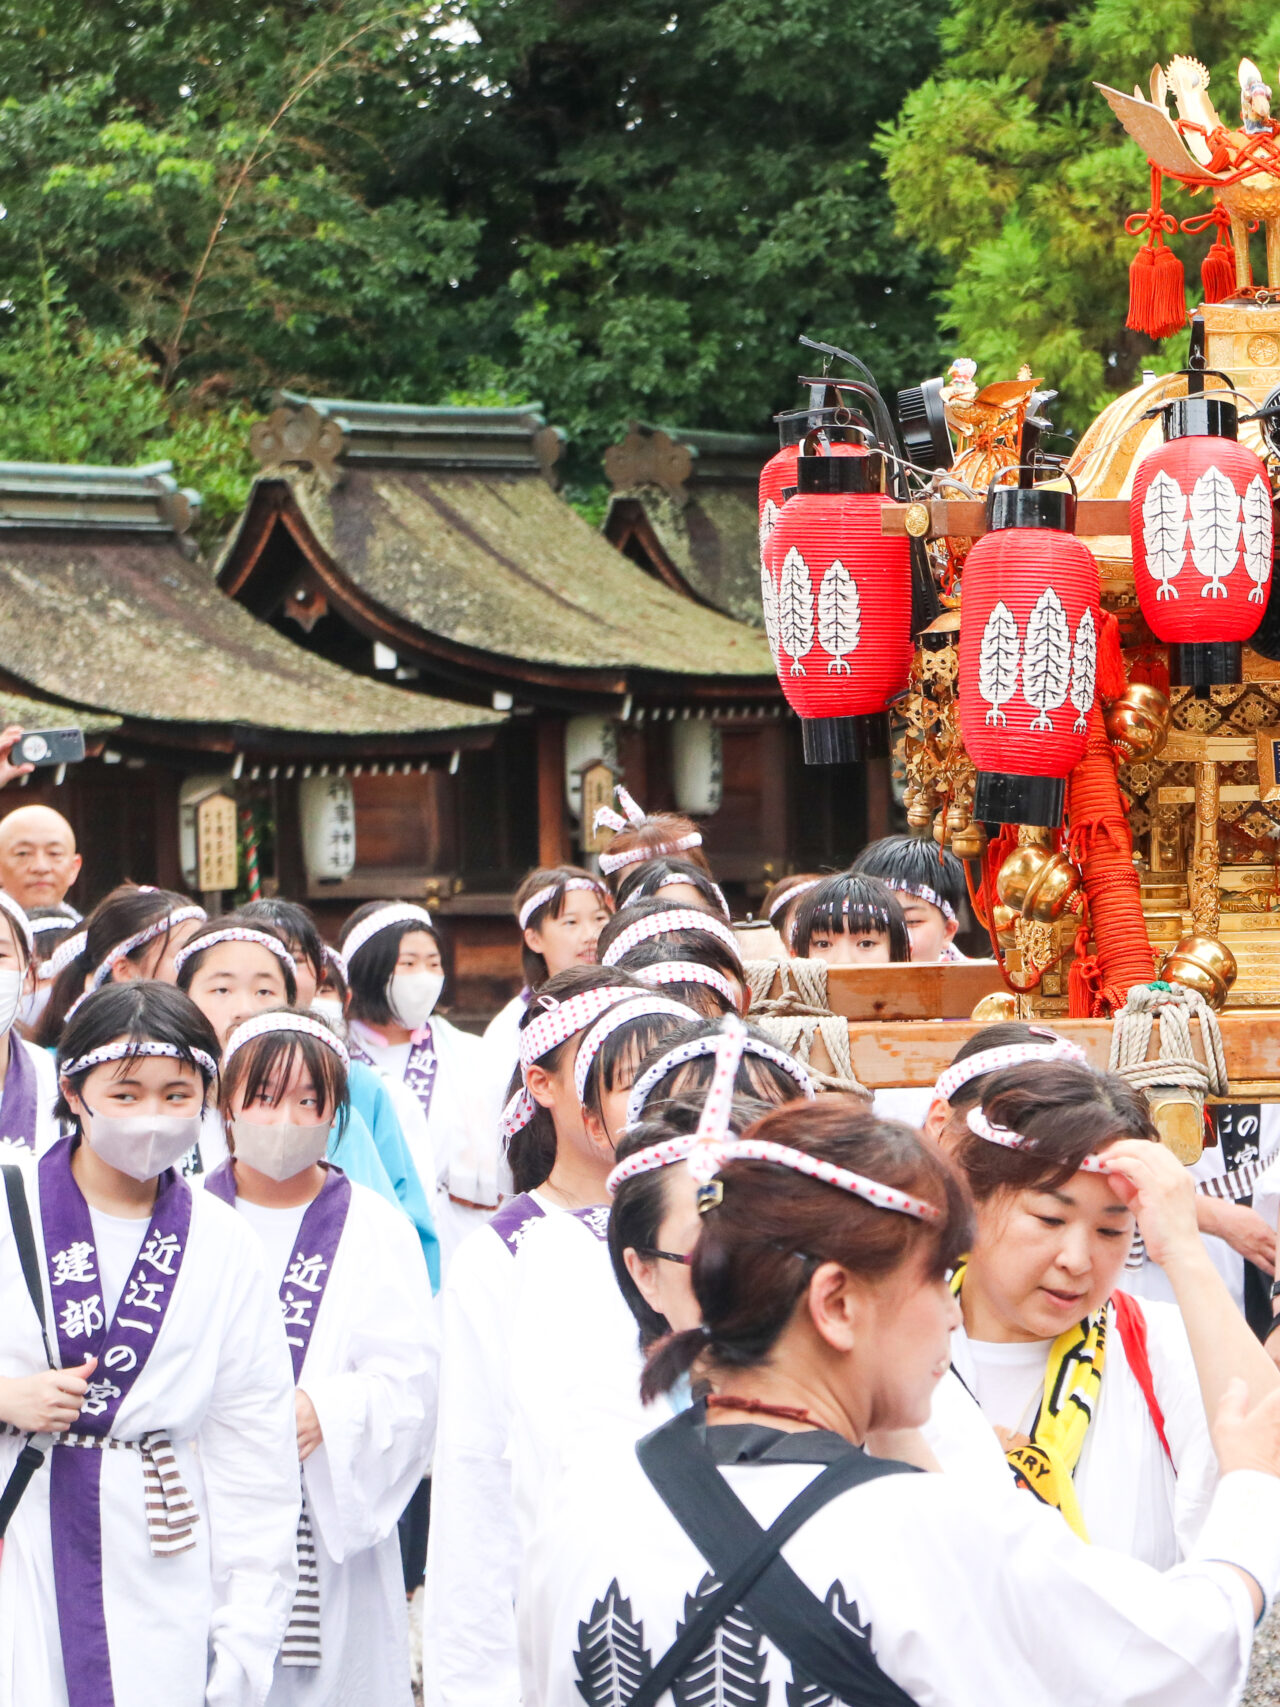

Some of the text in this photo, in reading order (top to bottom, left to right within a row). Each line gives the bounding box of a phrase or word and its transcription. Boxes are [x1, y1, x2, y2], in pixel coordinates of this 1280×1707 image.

[404, 1049, 438, 1109] 近江
[51, 1241, 103, 1364] 建部
[81, 1229, 181, 1416] 近江一の宮
